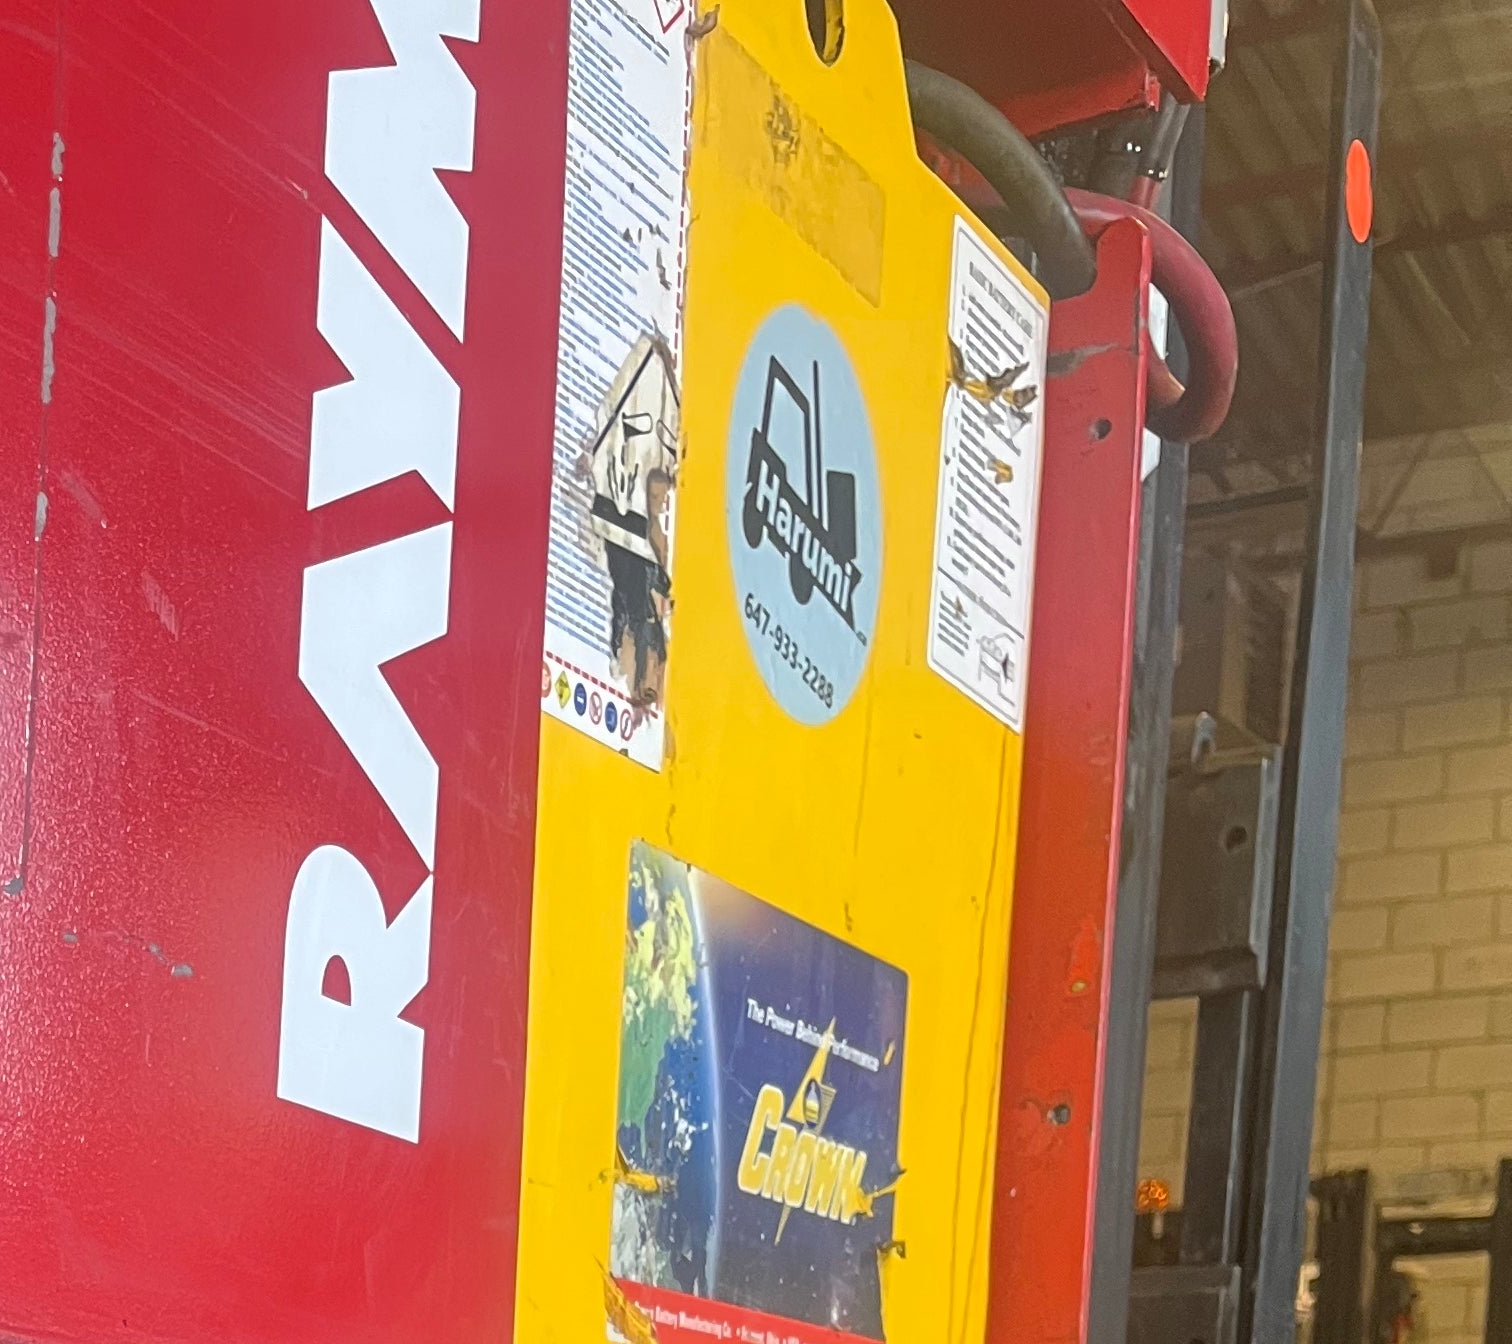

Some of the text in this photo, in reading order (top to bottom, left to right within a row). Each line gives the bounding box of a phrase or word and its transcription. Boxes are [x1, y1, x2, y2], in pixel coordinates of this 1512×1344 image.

[756, 459, 853, 613] Harumi
[744, 592, 835, 709] 647-933-2288
[747, 997, 765, 1024] The
[765, 1005, 795, 1036] Power
[737, 1083, 868, 1225] CROWN
